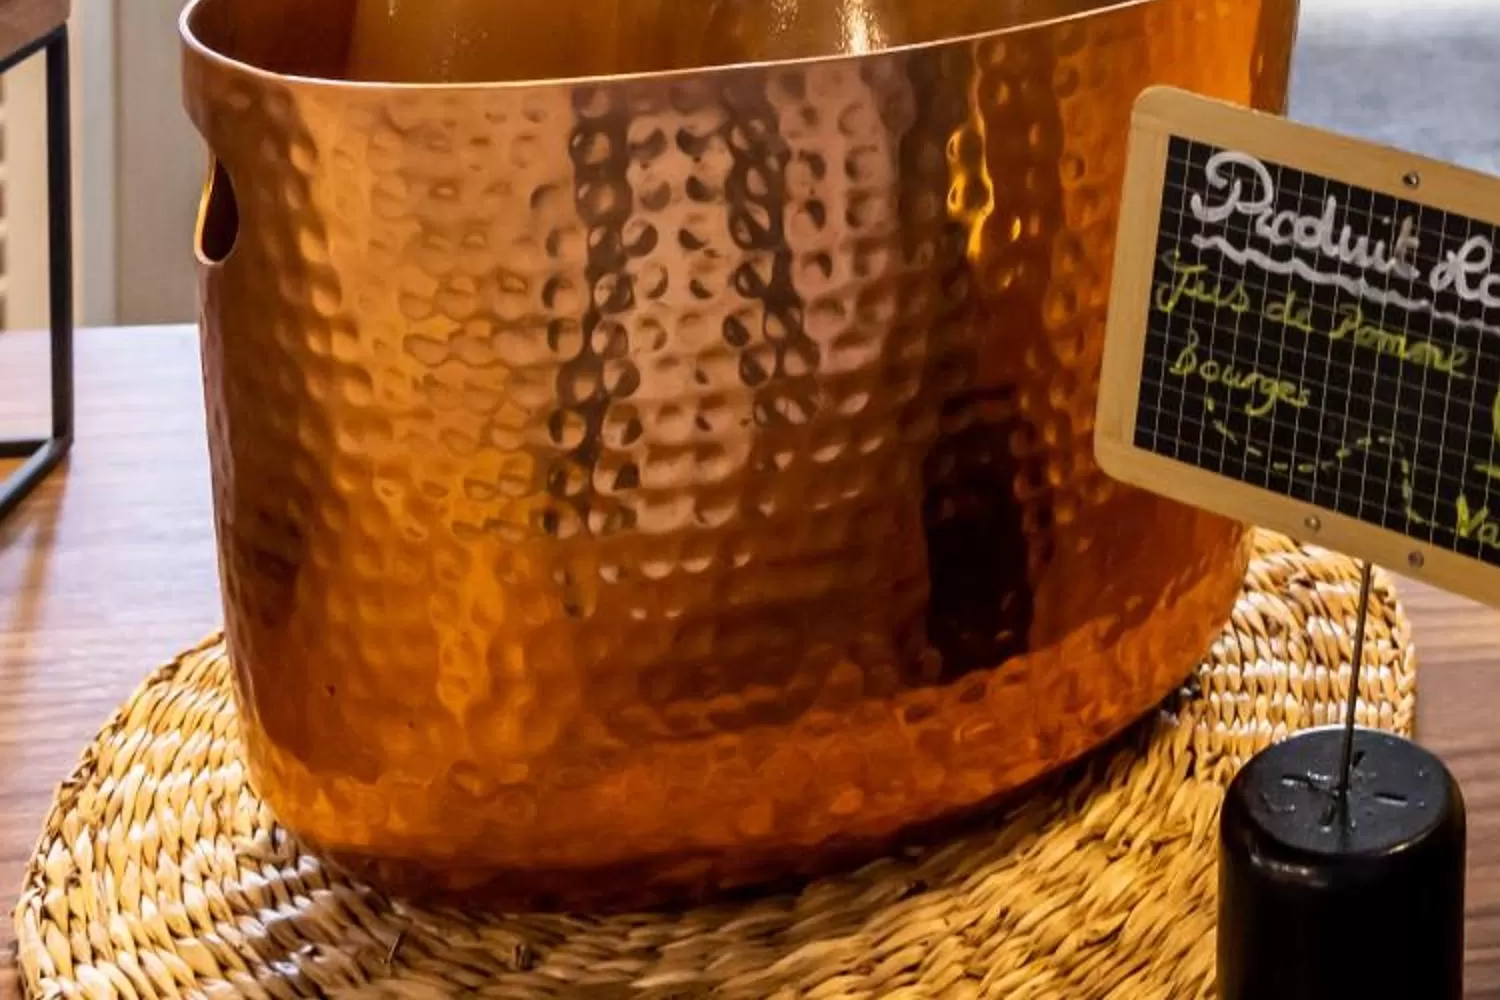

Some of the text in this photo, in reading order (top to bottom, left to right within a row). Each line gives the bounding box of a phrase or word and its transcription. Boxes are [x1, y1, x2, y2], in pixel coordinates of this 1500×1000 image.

[1190, 151, 1421, 279] Produit
[1156, 250, 1250, 313] Jus
[1266, 291, 1315, 332] de
[1168, 327, 1311, 417] Bourges
